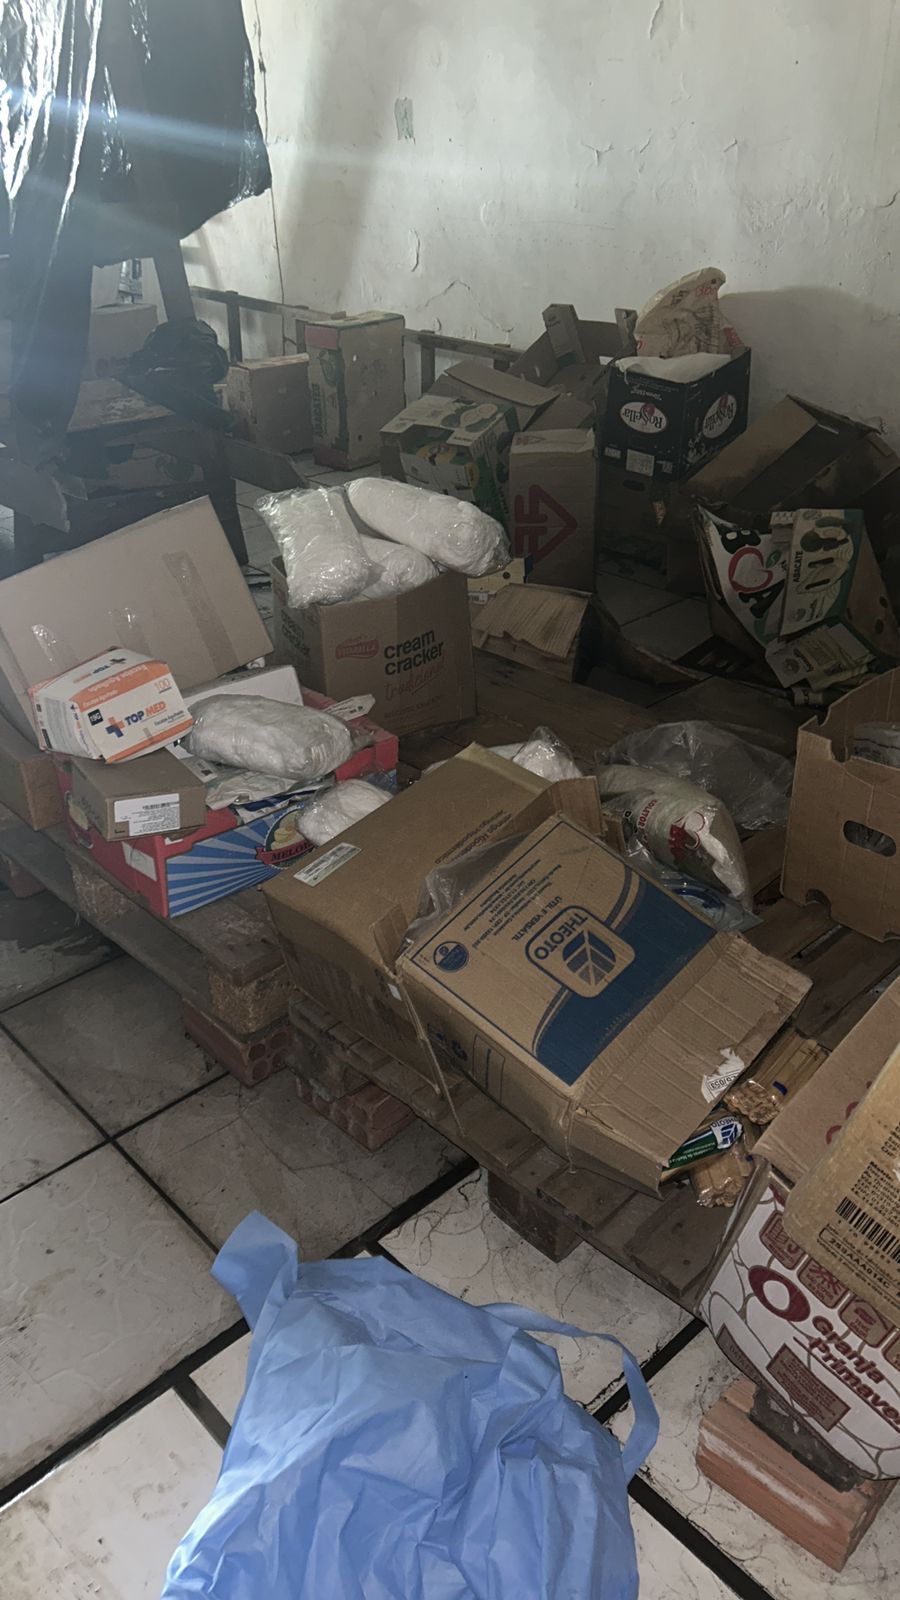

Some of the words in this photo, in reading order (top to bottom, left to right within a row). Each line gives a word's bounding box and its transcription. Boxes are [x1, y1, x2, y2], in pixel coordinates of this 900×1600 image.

[384, 630, 435, 659] cream
[384, 641, 444, 675] cracker
[154, 678, 171, 690] 100
[124, 710, 144, 726] TOP
[145, 701, 167, 717] MED
[534, 912, 588, 960] THEOTO
[812, 1315, 885, 1384] Granja
